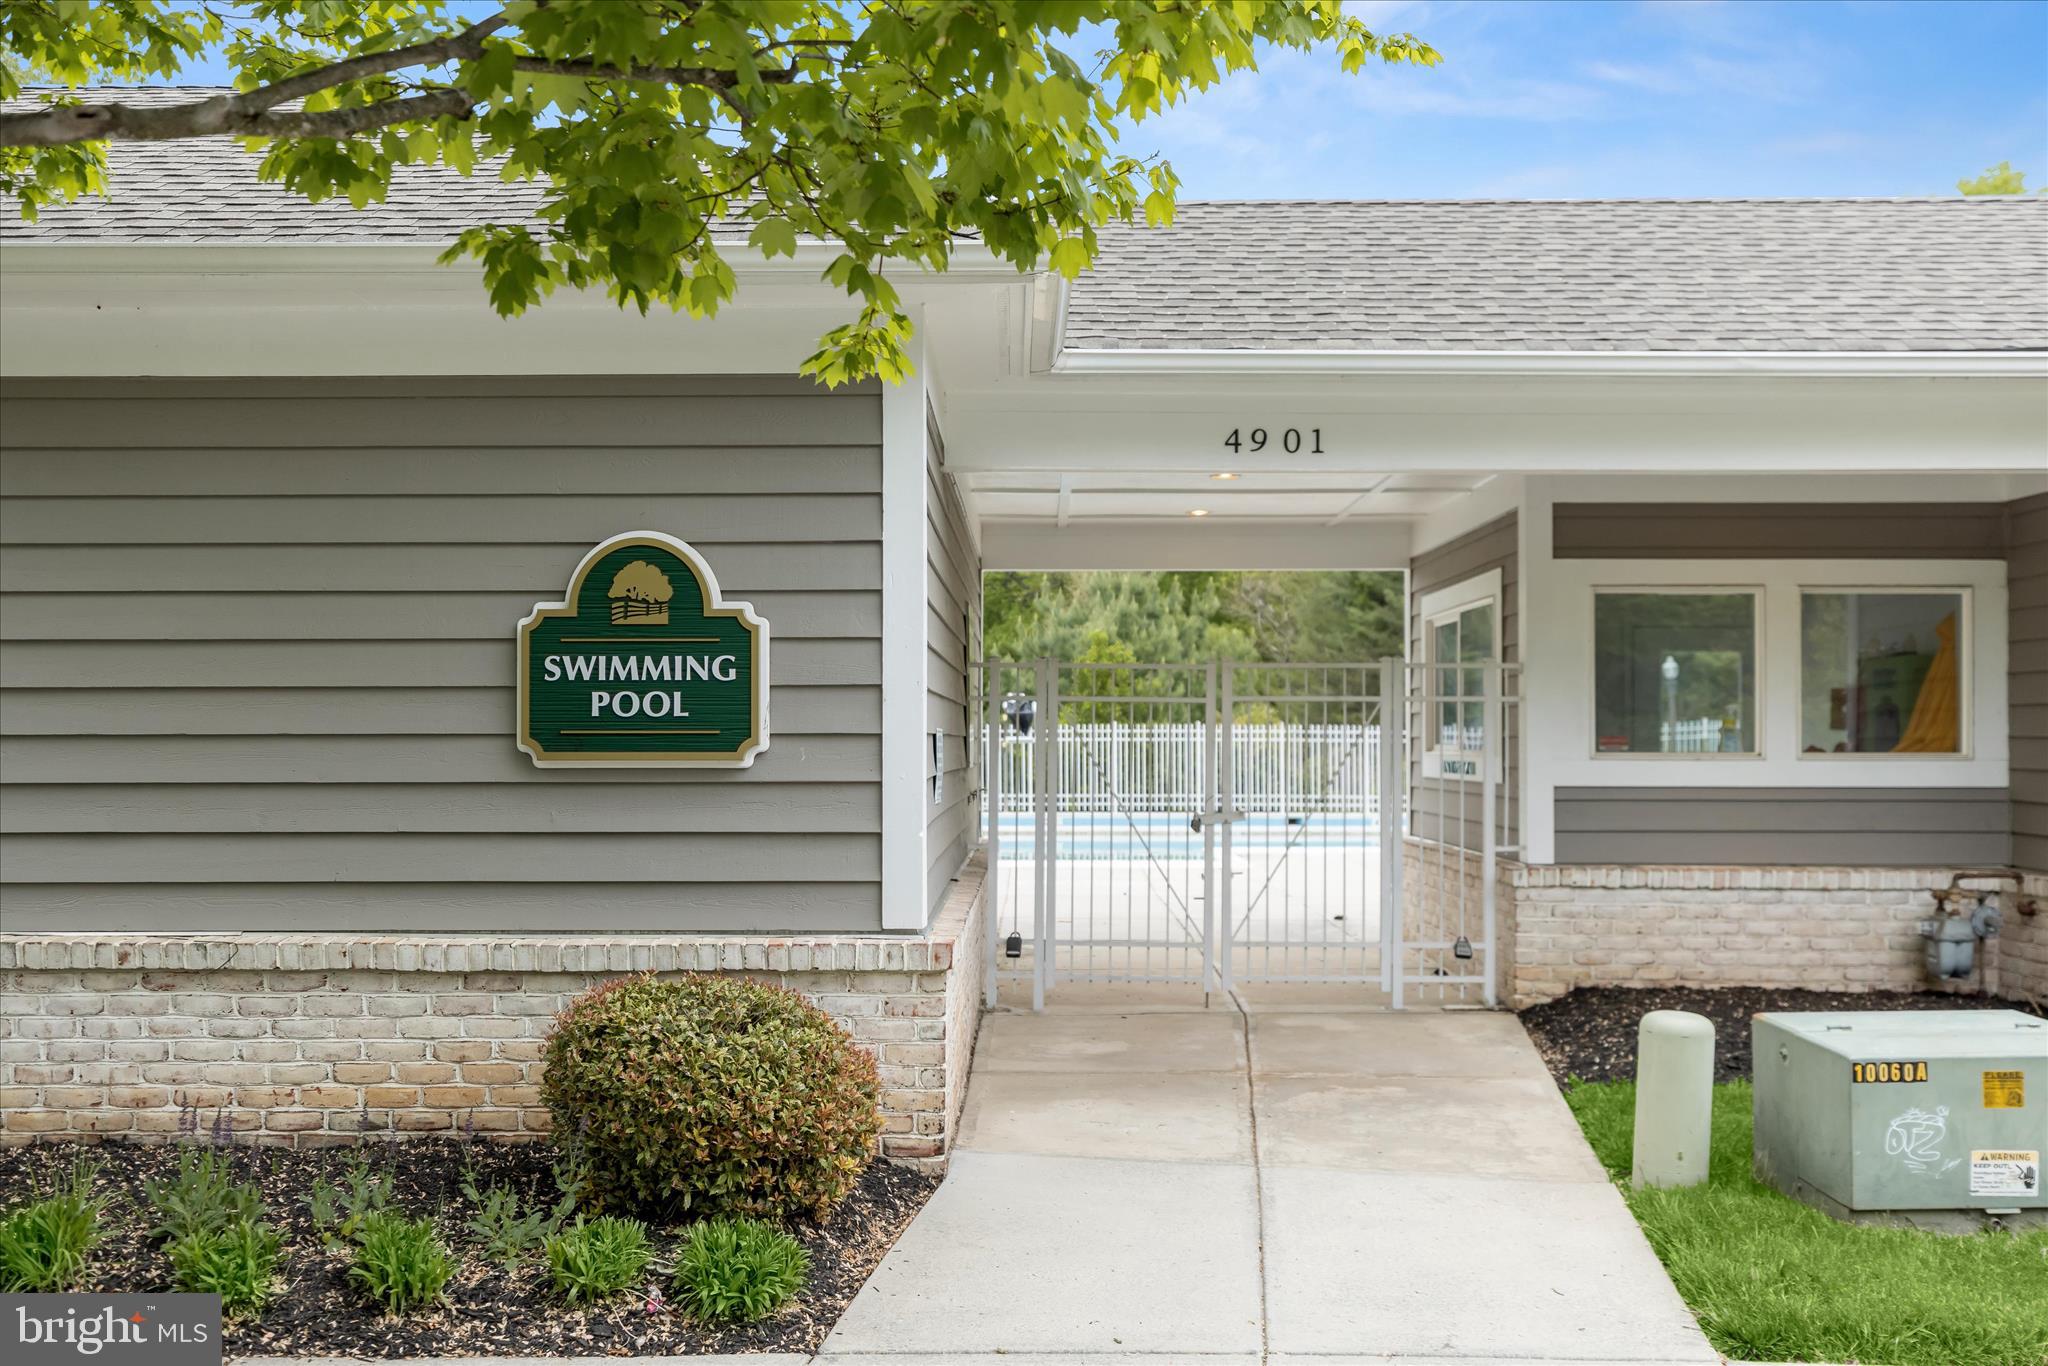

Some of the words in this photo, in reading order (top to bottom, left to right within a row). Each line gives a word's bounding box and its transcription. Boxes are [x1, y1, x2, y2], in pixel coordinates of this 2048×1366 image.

[544, 655, 736, 681] SWIMMING
[591, 691, 689, 717] POOL
[1854, 1062, 1927, 1082] 10060A
[1990, 1153, 2031, 1161] WARNING
